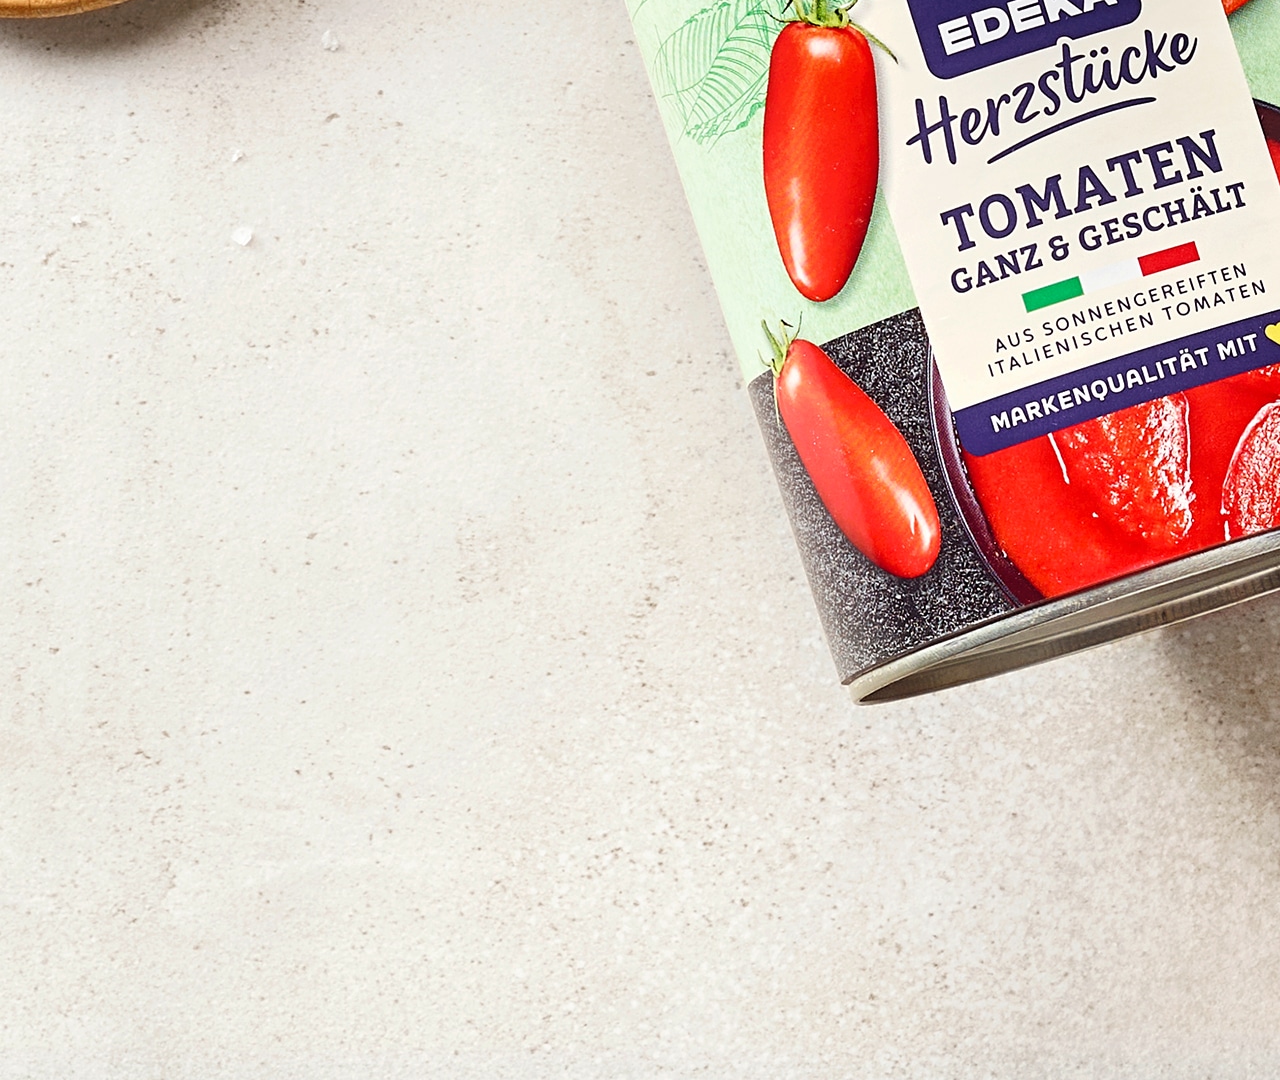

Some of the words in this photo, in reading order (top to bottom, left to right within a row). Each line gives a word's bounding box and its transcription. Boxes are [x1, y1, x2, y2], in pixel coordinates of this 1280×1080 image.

[905, 29, 1198, 164] Herzstücke
[940, 128, 1223, 252] TOMATEN
[950, 243, 1044, 294] GANZ
[1048, 235, 1070, 261] &
[1078, 182, 1247, 251] GESCHÄLT
[987, 312, 1154, 377] ITALIENISCHEN
[1161, 279, 1267, 321] TOMATEN
[995, 328, 1035, 353] AUS
[1042, 263, 1248, 337] SONNENGEREIFTEN
[989, 348, 1210, 433] MARKENQUALITÄT
[1215, 333, 1259, 362] MIT
